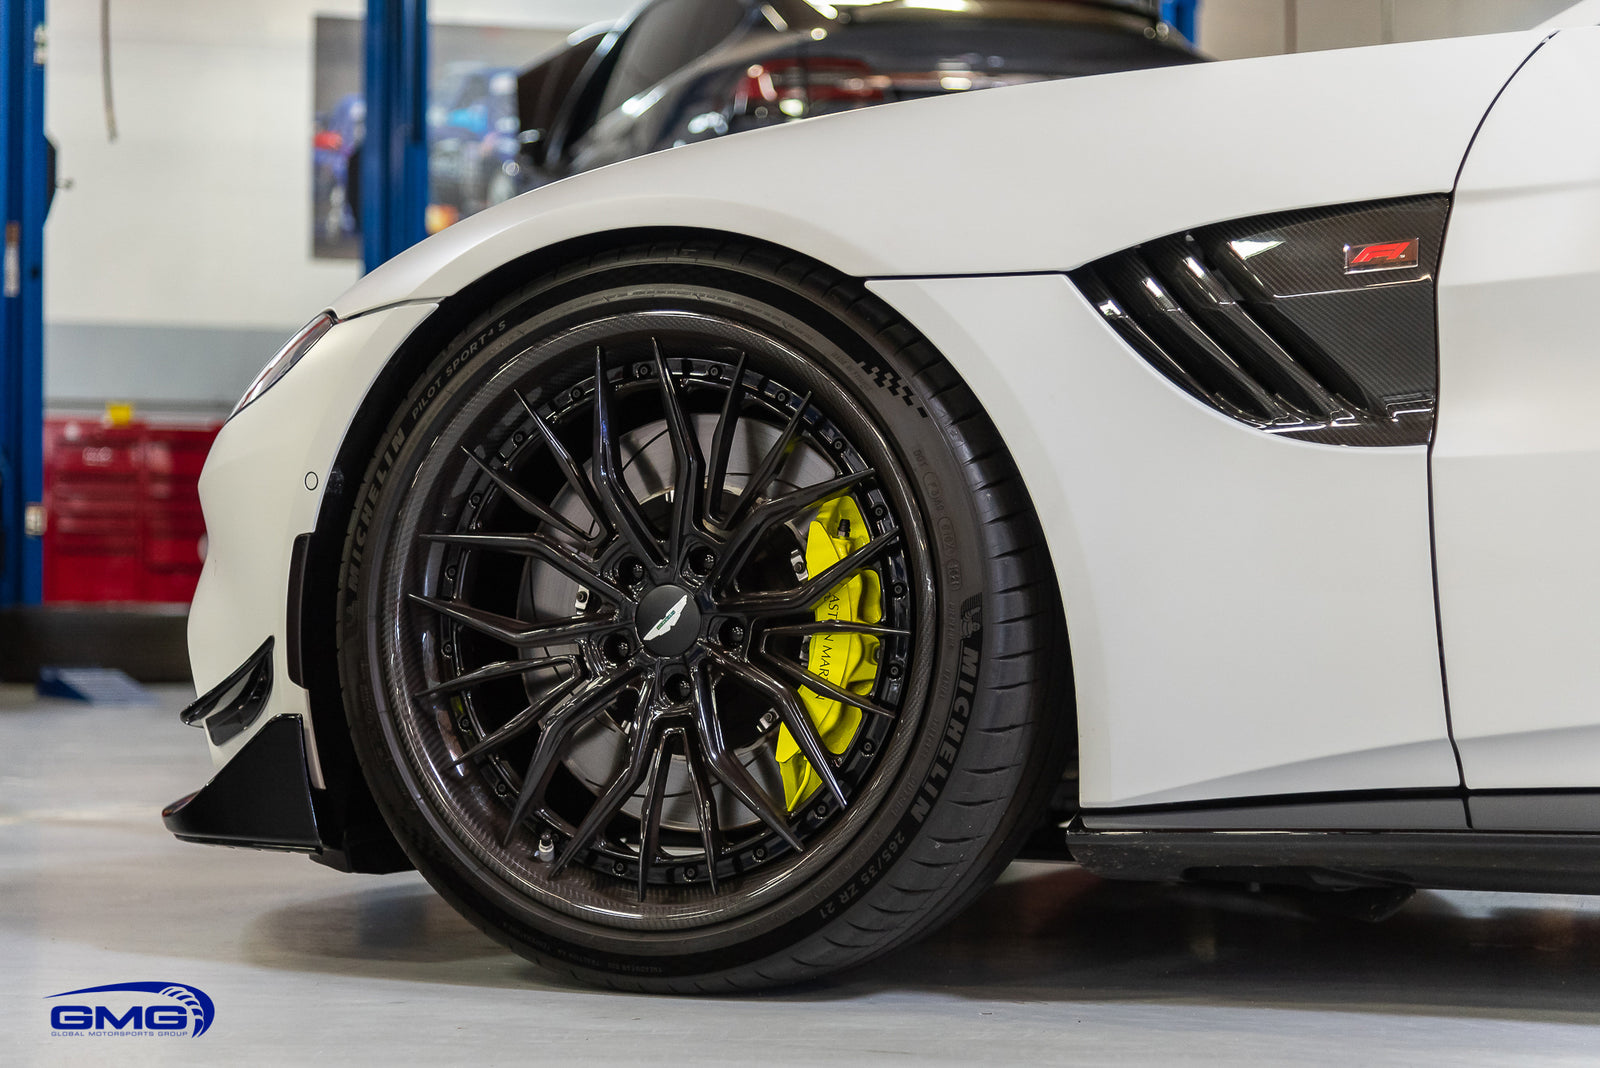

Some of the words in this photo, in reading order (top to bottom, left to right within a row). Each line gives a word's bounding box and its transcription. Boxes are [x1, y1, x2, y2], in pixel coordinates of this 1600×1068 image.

[411, 375, 441, 420] PILOT
[349, 430, 406, 592] MICHELIN
[909, 648, 982, 824] MICHELIN
[860, 831, 905, 885] 265/35
[819, 901, 836, 919] 21
[839, 882, 858, 904] ZR
